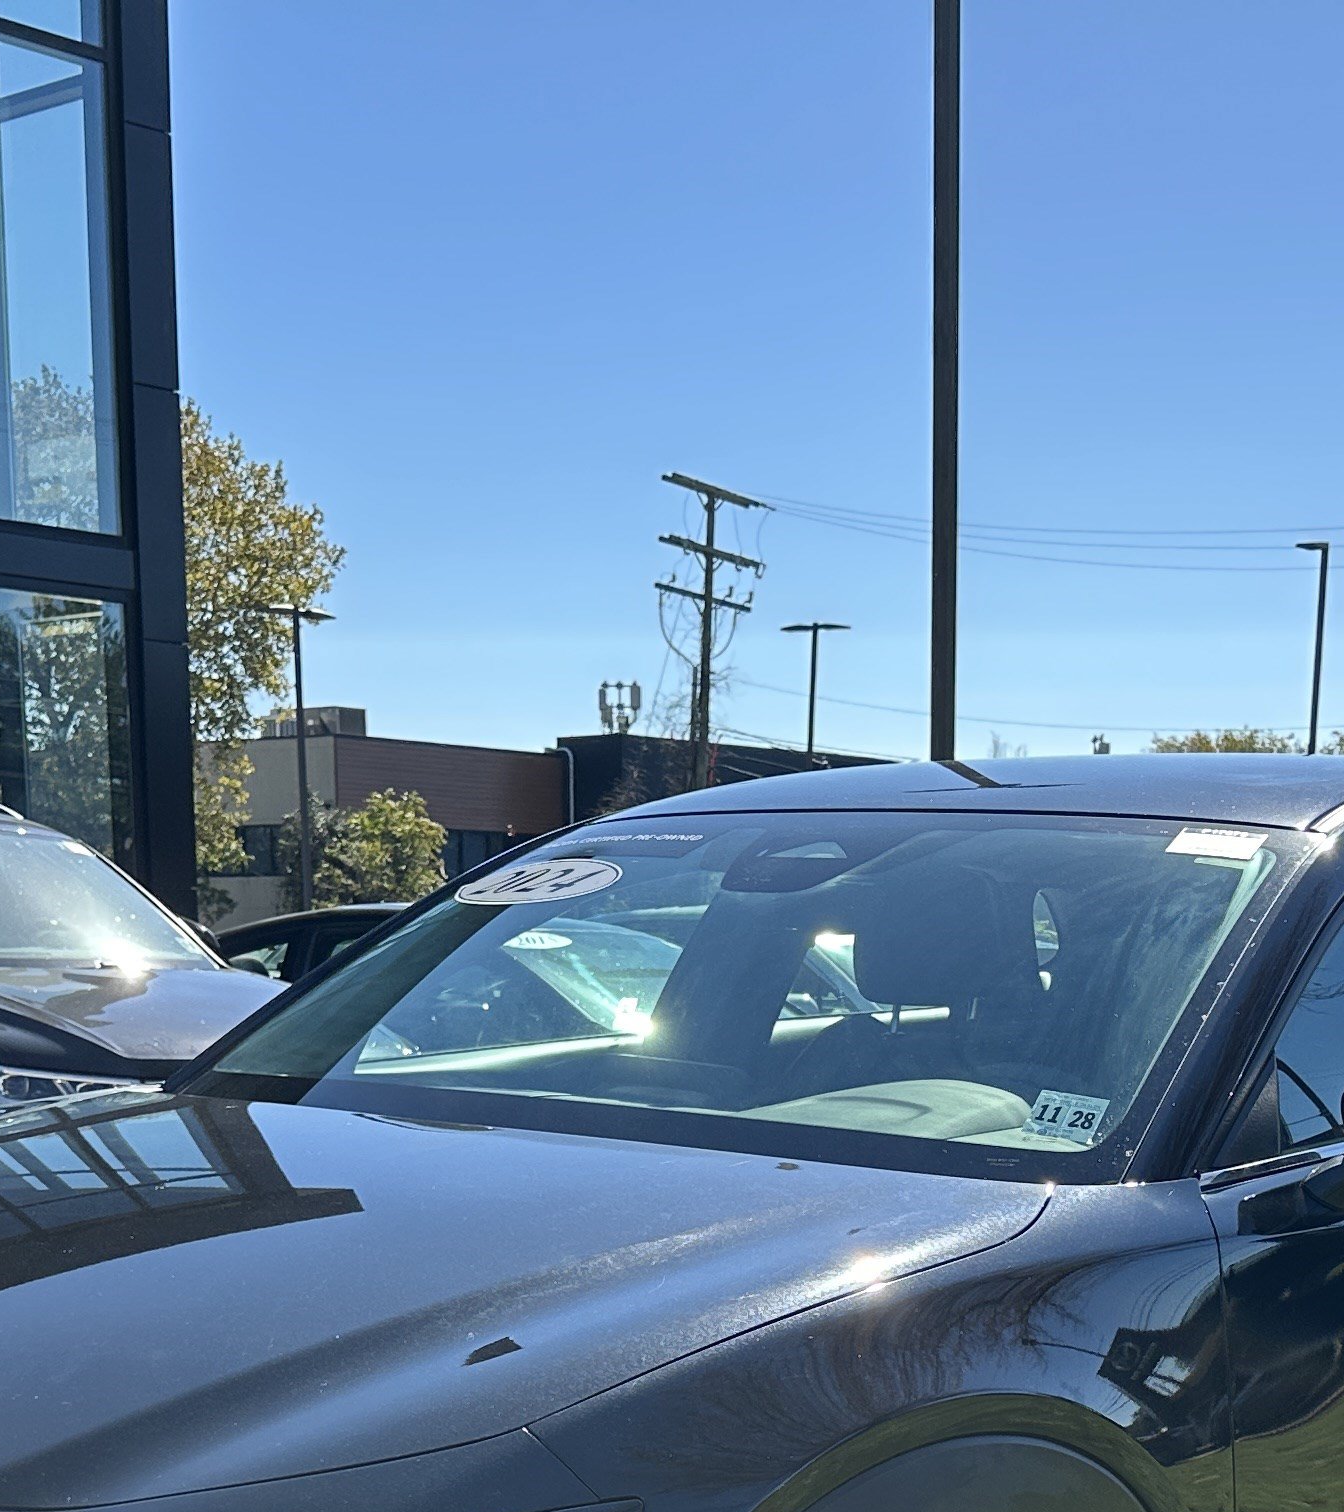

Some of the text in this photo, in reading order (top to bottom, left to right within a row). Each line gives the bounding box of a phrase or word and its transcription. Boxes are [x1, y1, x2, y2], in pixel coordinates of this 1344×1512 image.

[633, 834, 704, 842] PRE-OWNED
[466, 868, 608, 896] 2024
[1034, 1103, 1096, 1130] 11 28
